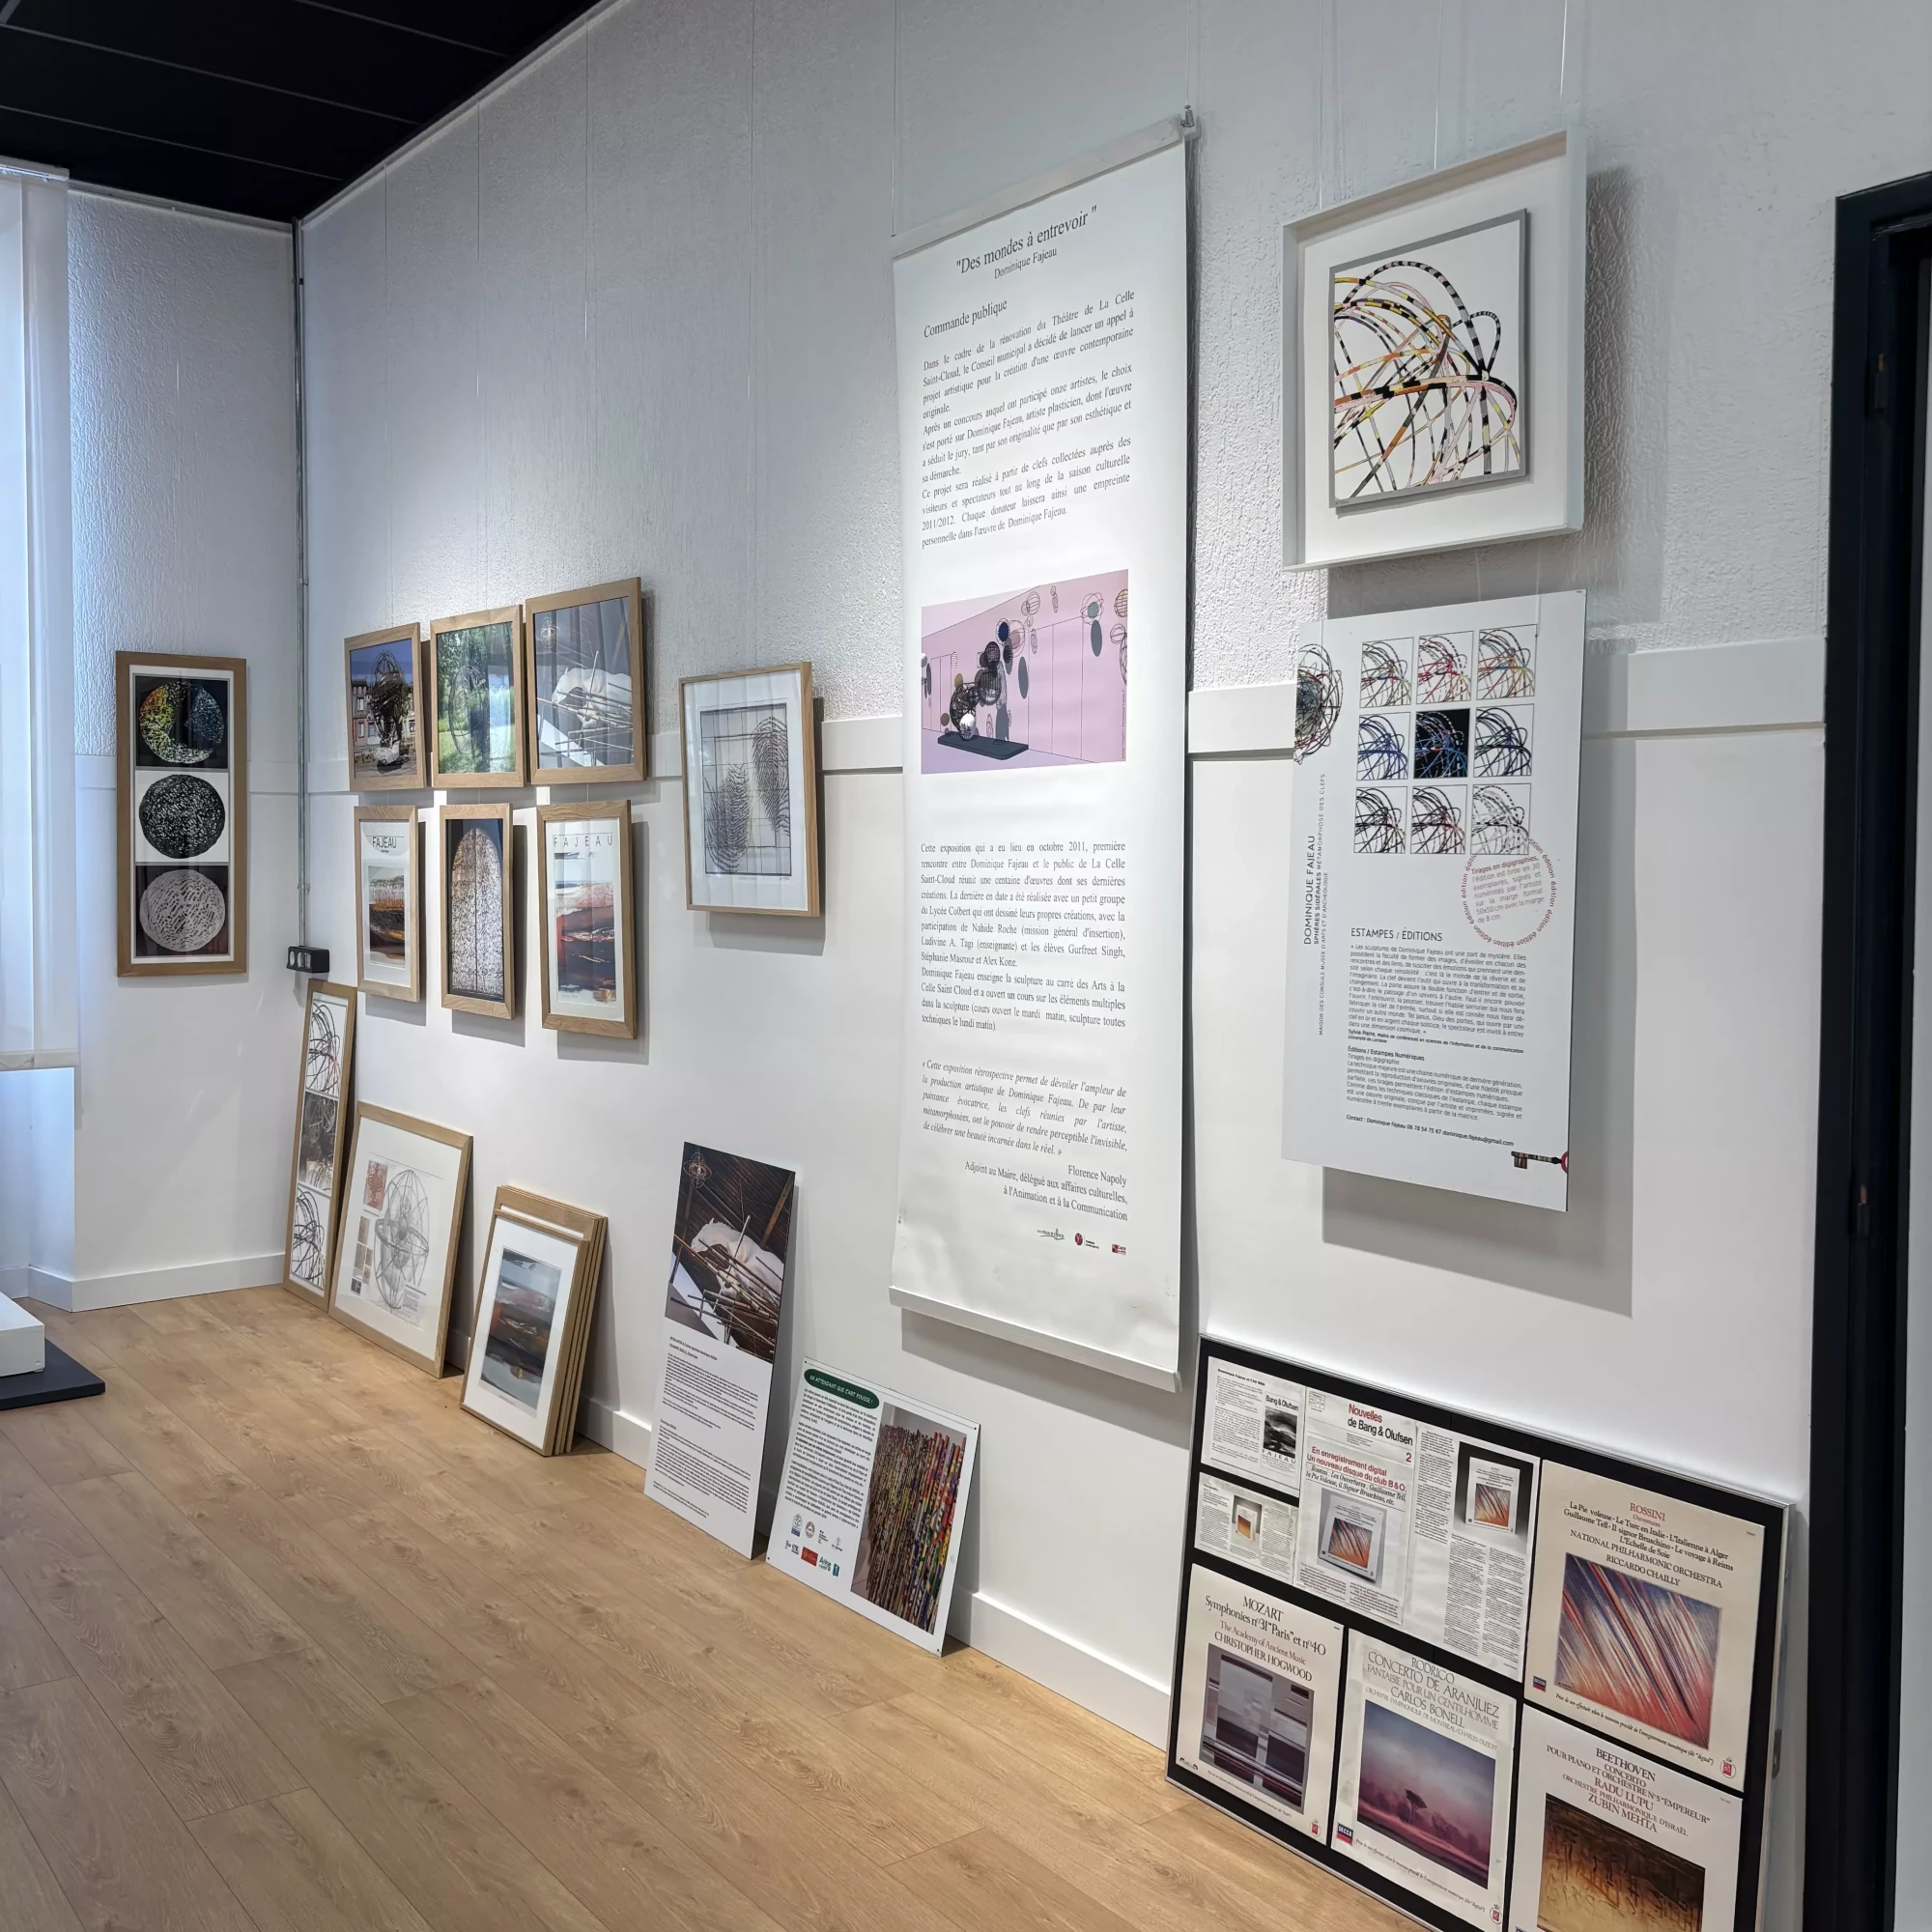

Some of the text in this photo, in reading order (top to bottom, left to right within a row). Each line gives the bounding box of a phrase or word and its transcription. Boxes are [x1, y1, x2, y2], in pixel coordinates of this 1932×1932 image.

[984, 239, 1023, 265] mondes
[1027, 231, 1034, 247] à
[994, 248, 1057, 279] Dominique Fajeau
[923, 300, 1007, 338] Commande publique
[923, 290, 1134, 371] Dans le cadre de la rénovation du Théâtre de La Celle
[373, 838, 396, 848] FAJEAU
[554, 835, 612, 847] FAJEAU
[1304, 836, 1316, 945] DOMINIQUE FAJEAU
[1351, 927, 1394, 939] ESTAMPES
[1402, 926, 1442, 942] ÉDITIONS
[964, 1161, 987, 1174] Adjoint
[998, 1167, 1018, 1181] Maire,
[1020, 1172, 1045, 1187] délégué
[1047, 1179, 1060, 1189] aux
[1061, 1180, 1087, 1194] affaires
[1088, 1187, 1127, 1205] culturelles,
[1068, 1165, 1126, 1188] Florence Napoly
[1004, 1185, 1008, 1194] à
[1009, 1185, 1047, 1204] l'Animation
[1057, 1196, 1062, 1206] à
[1063, 1198, 1069, 1208] la
[1070, 1200, 1127, 1221] Communication
[1265, 1395, 1277, 1406] Bang
[1282, 1400, 1298, 1411] Olufsen
[1349, 1404, 1382, 1423] Nouvelles
[1348, 1417, 1357, 1428] de
[1358, 1420, 1378, 1436] Bang
[1378, 1427, 1383, 1436] &
[1385, 1429, 1412, 1446] Olufsen
[1307, 1453, 1316, 1463] Un
[1316, 1459, 1343, 1471] nouveau
[1343, 1466, 1364, 1478] disque
[1373, 1476, 1387, 1486] club
[1312, 1446, 1387, 1476] En enregistrement digital
[1406, 1452, 1411, 1463] 2
[1630, 1503, 1665, 1521] ROSSINI
[1564, 1509, 1595, 1524] Guillaume
[1596, 1519, 1608, 1528] Tell
[1611, 1523, 1617, 1532] Il
[1618, 1527, 1637, 1539] signor
[1638, 1532, 1671, 1549] Bruschino
[1675, 1545, 1683, 1554] Le
[1684, 1550, 1706, 1562] voyage
[1712, 1557, 1733, 1571] Reims
[1570, 1501, 1577, 1510] La
[1577, 1504, 1588, 1513] Pie
[1590, 1510, 1614, 1520] voleuse
[1625, 1519, 1640, 1530] Turc
[1650, 1527, 1665, 1539] Italie
[1669, 1534, 1704, 1551] L'Italienne
[1710, 1548, 1728, 1559] Alger
[1571, 1529, 1722, 1588] NATIONAL PHILHARMONIC ORCHESTRA
[1648, 1546, 1656, 1554] de
[1657, 1548, 1670, 1558] Soie
[1606, 1554, 1680, 1586] RICCARDO CHAILLY
[1206, 1596, 1250, 1623] Symphonies
[1293, 1632, 1301, 1646] et
[1243, 1596, 1284, 1621] MOZART
[1214, 1632, 1312, 1681] CHRISTOPHER HOGWOOD
[1220, 1620, 1306, 1665] The Academy of Ancient Music
[1367, 1664, 1401, 1686] FANTAISIE
[1403, 1680, 1422, 1696] POUR
[1424, 1689, 1435, 1702] UN
[1368, 1652, 1499, 1719] CONCERTO DE ARANJUEZ
[1391, 1687, 1464, 1728] CARLOS BONELL
[1547, 1745, 1567, 1760] POUR
[1568, 1754, 1591, 1770] PIANO
[1592, 1766, 1601, 1776] ET
[1602, 1771, 1647, 1797] ORCHESTRE
[1596, 1748, 1656, 1781] BEETHOVEN
[1604, 1764, 1646, 1787] CONCERTO
[1563, 1774, 1598, 1795] ORCHESTRE
[1600, 1791, 1658, 1822] PHILHARMONIQUE
[1595, 1777, 1654, 1810] RADU LUPU
[1588, 1794, 1657, 1833] ZUBIN MEHTA
[1338, 1825, 1352, 1836] DECCA
